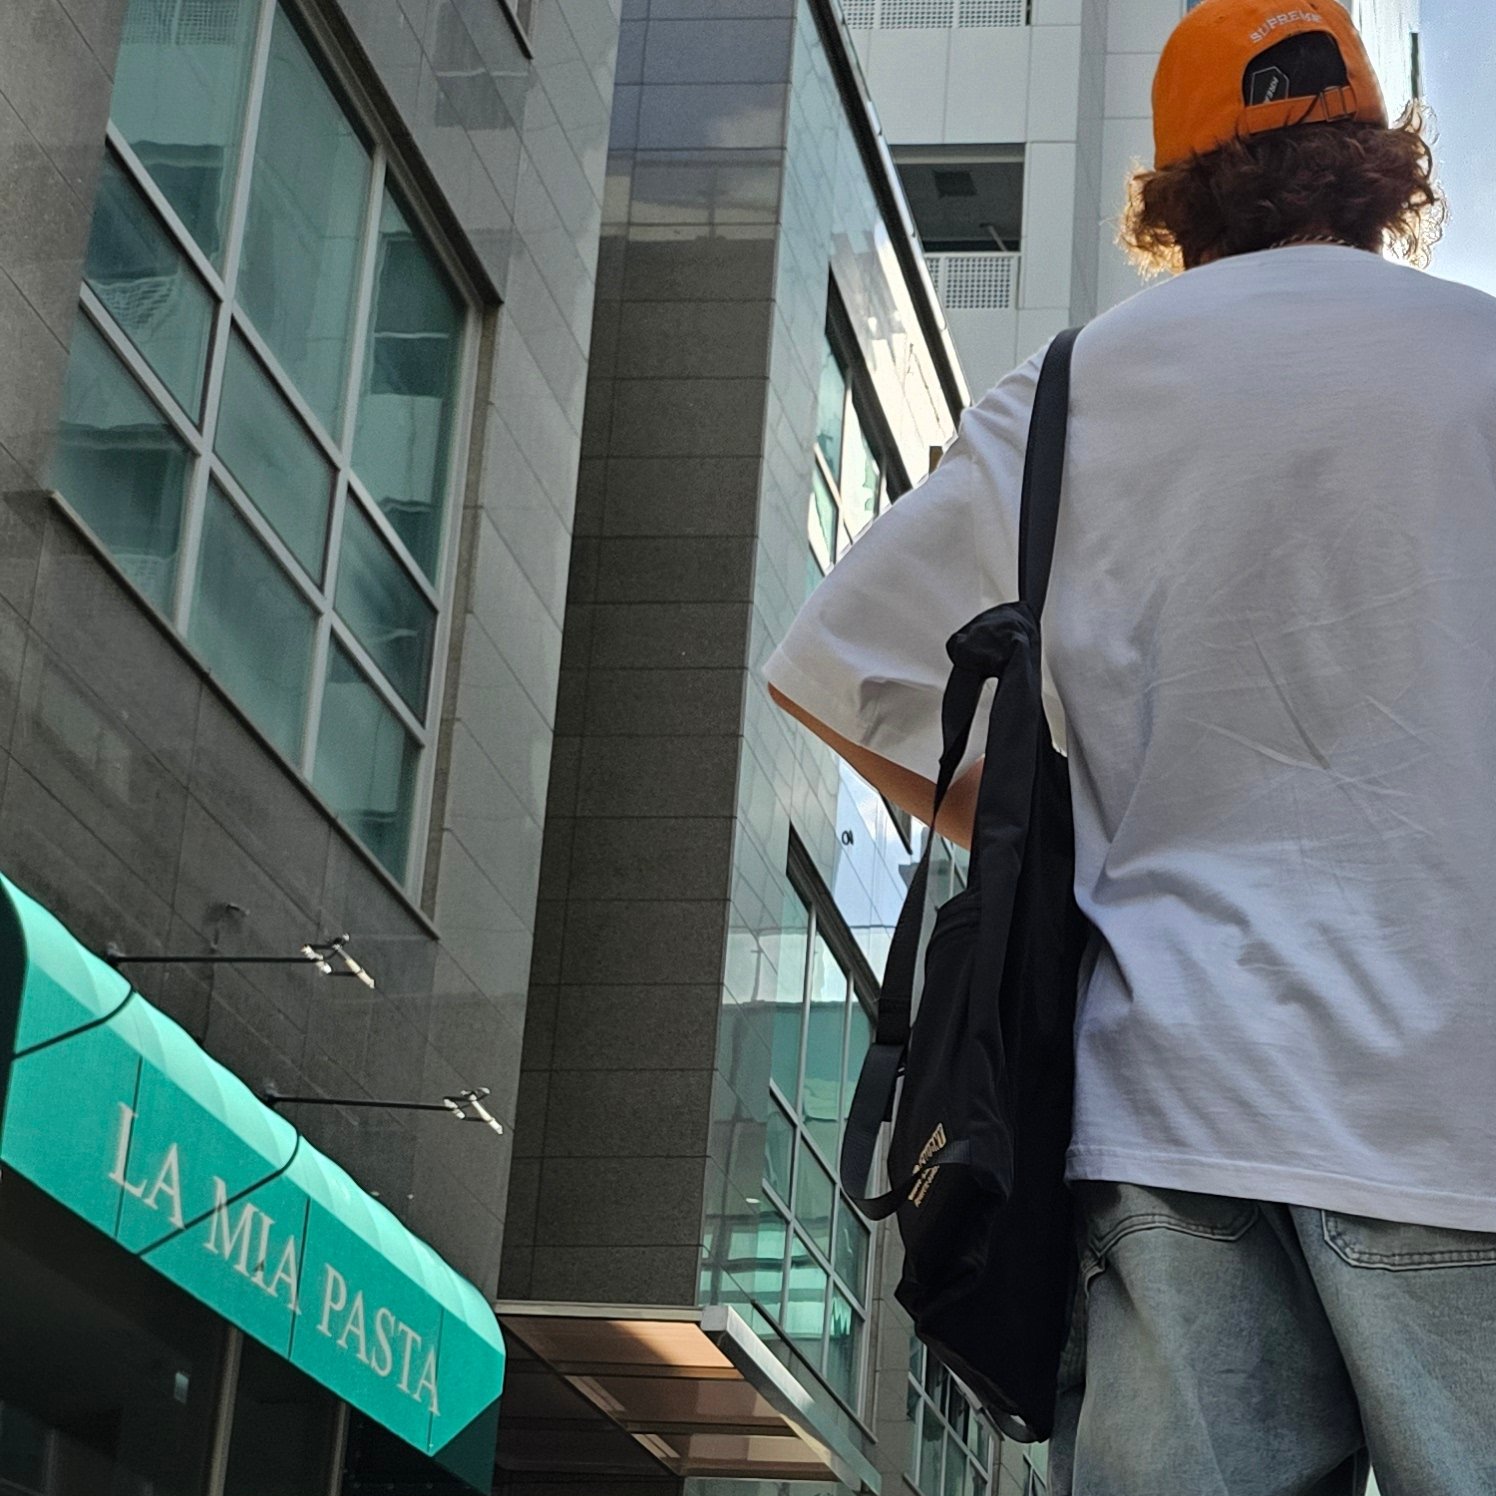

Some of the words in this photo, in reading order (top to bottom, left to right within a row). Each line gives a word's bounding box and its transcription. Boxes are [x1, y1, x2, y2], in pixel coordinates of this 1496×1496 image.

[1250, 9, 1323, 43] SUPREME
[108, 1102, 186, 1230] LA
[203, 1175, 302, 1315] MIA
[316, 1262, 441, 1416] PASTA
